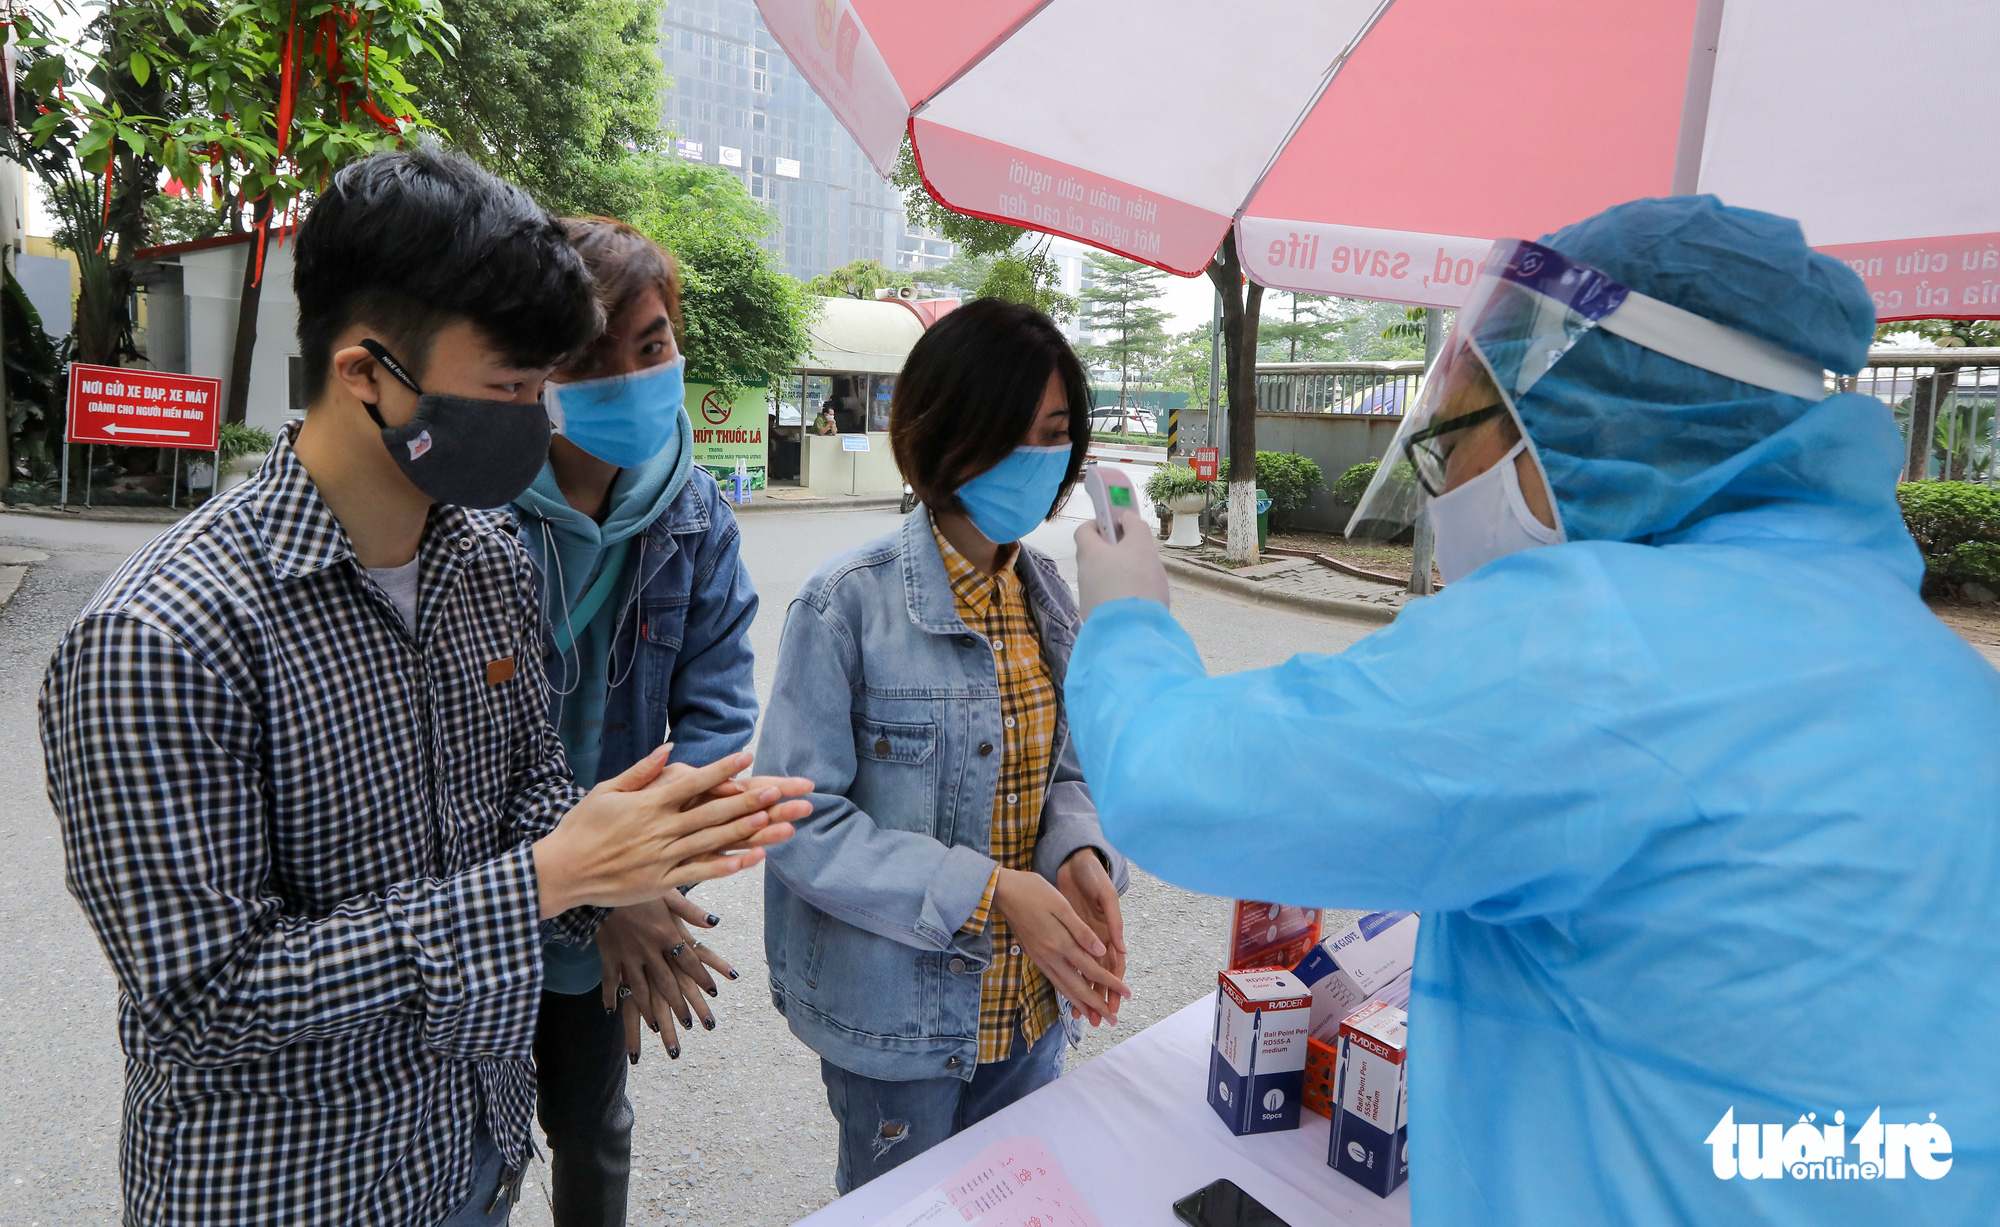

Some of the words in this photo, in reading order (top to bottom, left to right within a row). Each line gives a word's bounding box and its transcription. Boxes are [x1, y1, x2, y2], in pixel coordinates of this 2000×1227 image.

[382, 355, 397, 370] NIKE
[82, 380, 103, 394] NƠI
[105, 379, 124, 397] GỬI
[127, 385, 142, 398] XE
[144, 386, 167, 402] ĐẠP,
[169, 389, 183, 402] XE
[186, 389, 208, 404] MÁY
[88, 401, 115, 414] (DÀNH
[117, 404, 134, 415] CHO
[136, 404, 161, 417] NGƯỜI
[163, 406, 181, 419] HIẾN
[183, 409, 204, 421] MÁU)
[716, 425, 748, 444] THUỐC
[749, 427, 762, 444] LÁ
[1341, 931, 1360, 948] GLOVE
[1245, 975, 1282, 983] RD555-A
[1222, 981, 1244, 1007] RADDER
[1268, 999, 1303, 1010] RADDER
[1263, 1038, 1291, 1046] RD555-A
[1349, 1032, 1390, 1058] RADDER
[1358, 1077, 1366, 1097] Point
[1364, 1095, 1373, 1117] 555-A
[1372, 1090, 1380, 1121] medium
[1262, 1112, 1283, 1121] 50pcs
